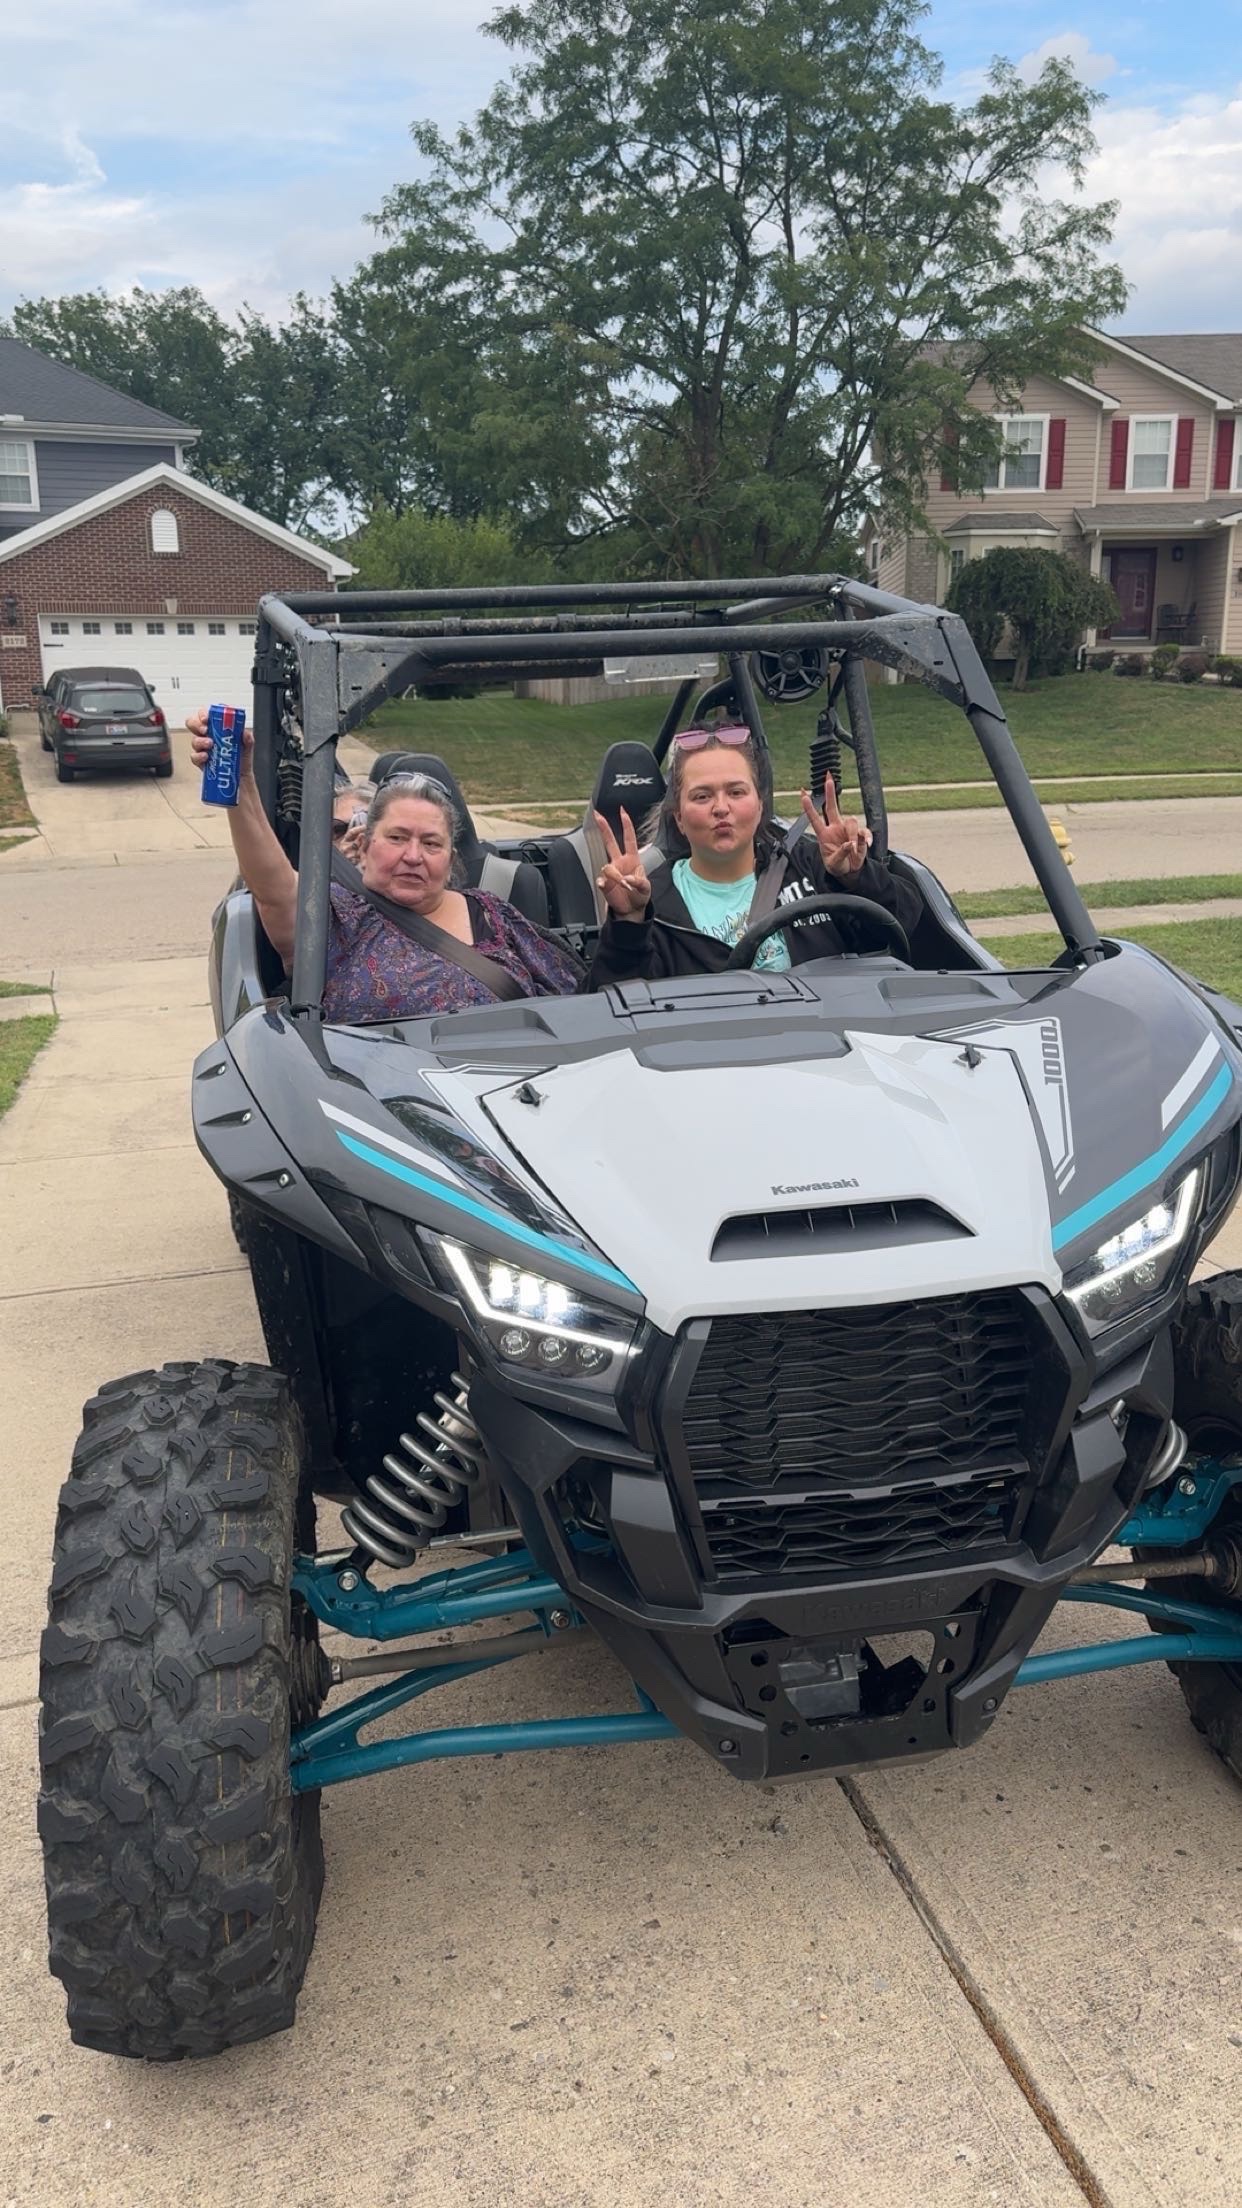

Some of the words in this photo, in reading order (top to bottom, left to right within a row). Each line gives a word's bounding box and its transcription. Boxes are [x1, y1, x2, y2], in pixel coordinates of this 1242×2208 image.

[217, 734, 234, 789] ULTRA
[1040, 1026, 1063, 1086] 1000
[770, 1178, 860, 1196] Kawasaki
